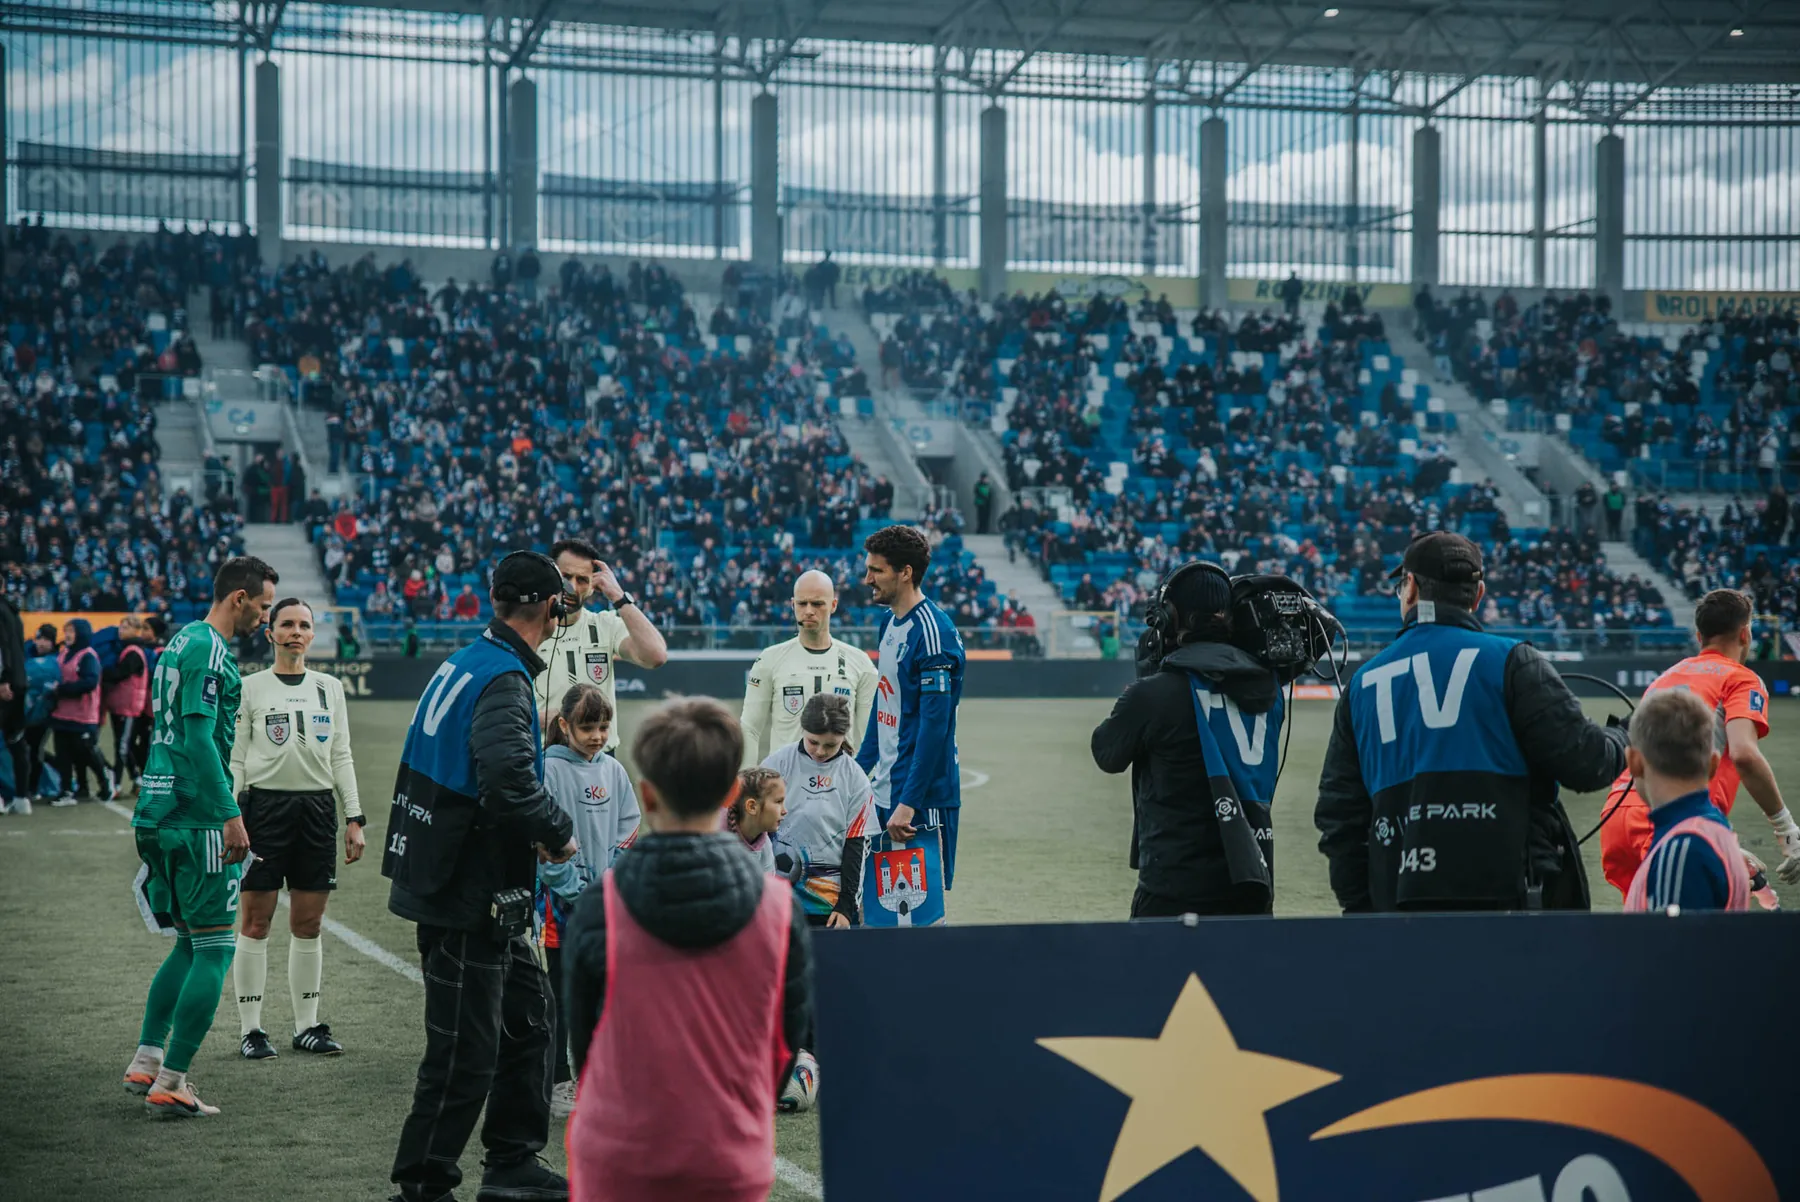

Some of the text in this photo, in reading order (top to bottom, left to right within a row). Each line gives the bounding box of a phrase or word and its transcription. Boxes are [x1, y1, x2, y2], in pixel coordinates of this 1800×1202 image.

[1256, 281, 1374, 300] ROZINY
[410, 661, 474, 737] TV
[834, 687, 851, 696] FIFA
[1362, 648, 1480, 744] TV
[1427, 803, 1497, 819] PARK
[1254, 827, 1273, 840] AR
